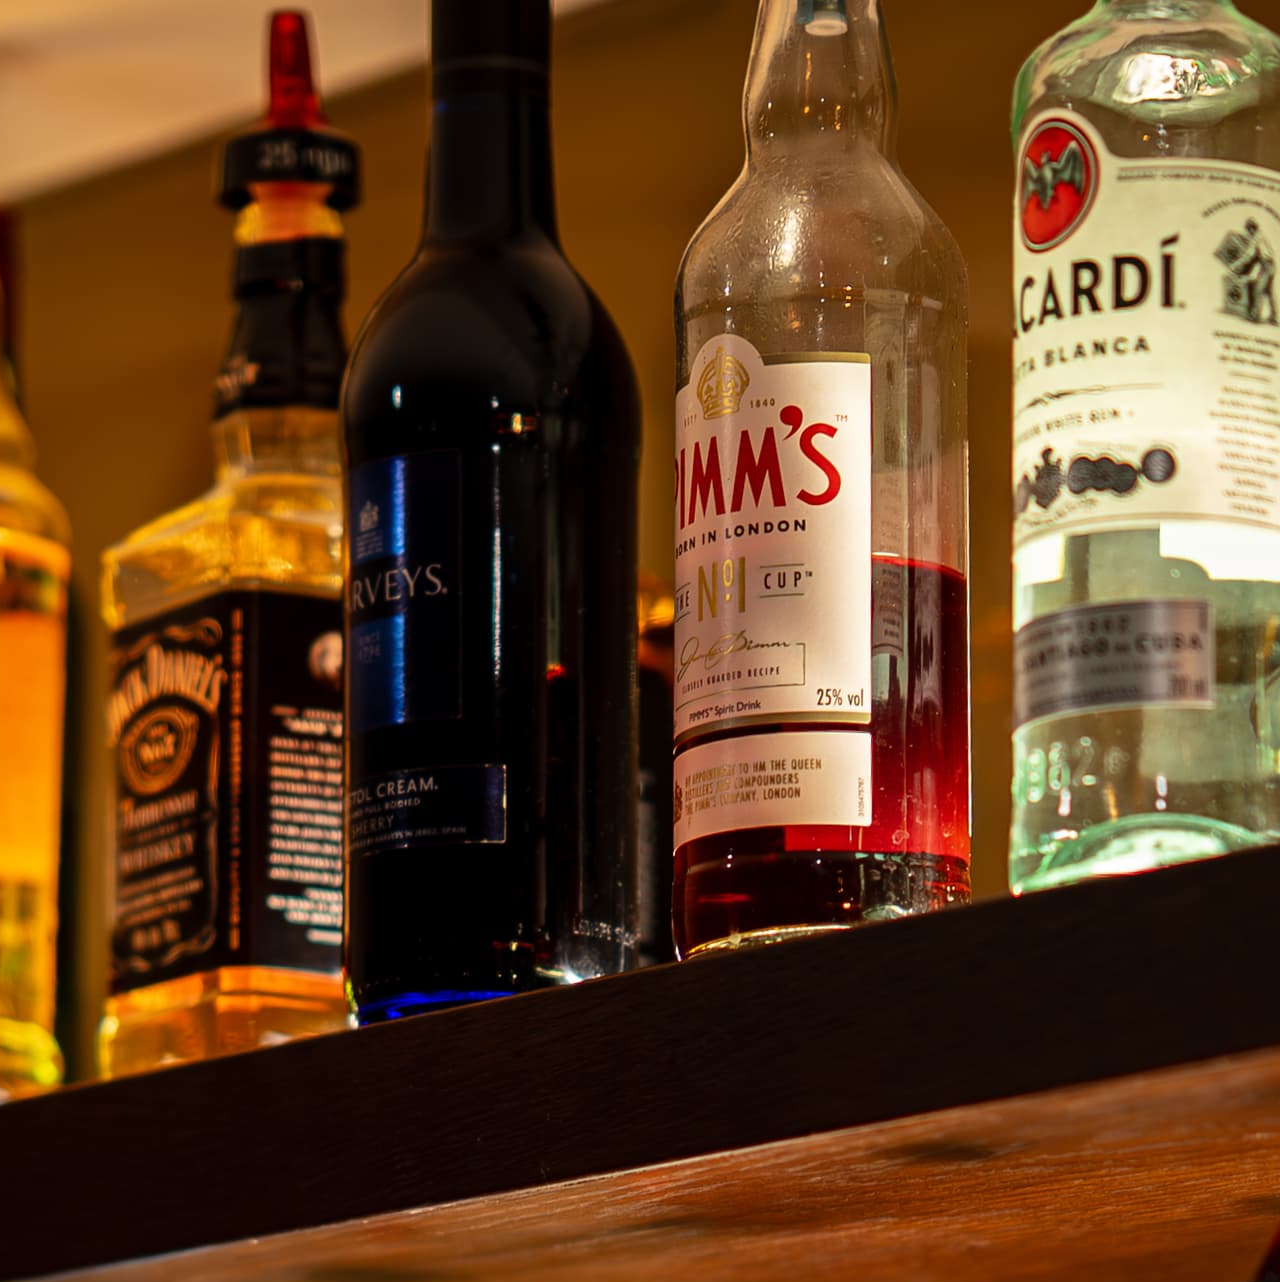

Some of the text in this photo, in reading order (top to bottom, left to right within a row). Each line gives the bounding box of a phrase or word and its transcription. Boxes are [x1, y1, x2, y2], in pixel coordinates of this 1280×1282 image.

[1012, 233, 1180, 340] CARDÍ
[750, 398, 776, 409] 1840
[702, 530, 717, 545] IN
[725, 519, 807, 539] LONDON
[747, 666, 780, 677] RECIPE
[816, 688, 865, 707] 25% vol
[714, 702, 735, 718] Spirit
[736, 700, 762, 713] Drink
[739, 760, 749, 773] TO
[770, 759, 786, 771] THE
[791, 758, 822, 770] QUEEN
[735, 773, 799, 790] COMPOUNDERS
[763, 787, 801, 801] LONDON
